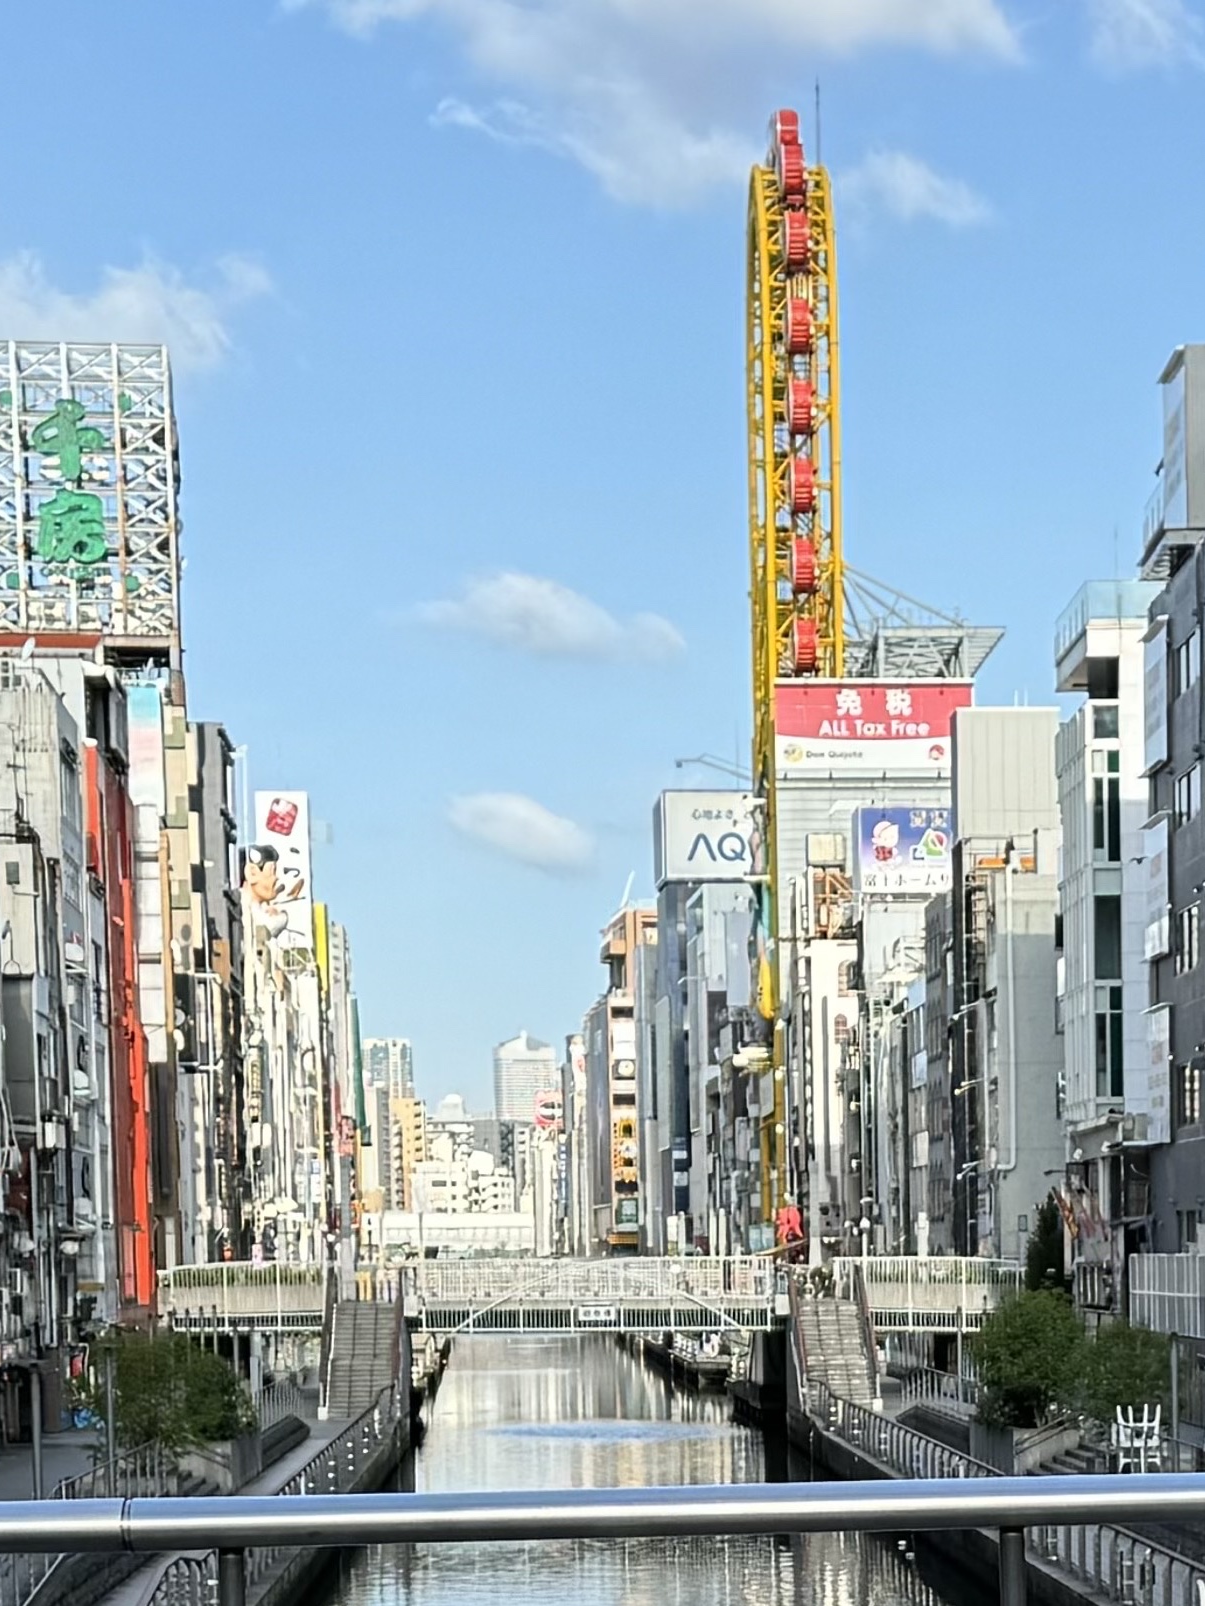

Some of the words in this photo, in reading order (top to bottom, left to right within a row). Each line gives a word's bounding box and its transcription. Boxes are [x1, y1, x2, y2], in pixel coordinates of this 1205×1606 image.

[819, 720, 850, 737] ALL
[854, 720, 886, 737] Tax
[891, 721, 931, 737] Free
